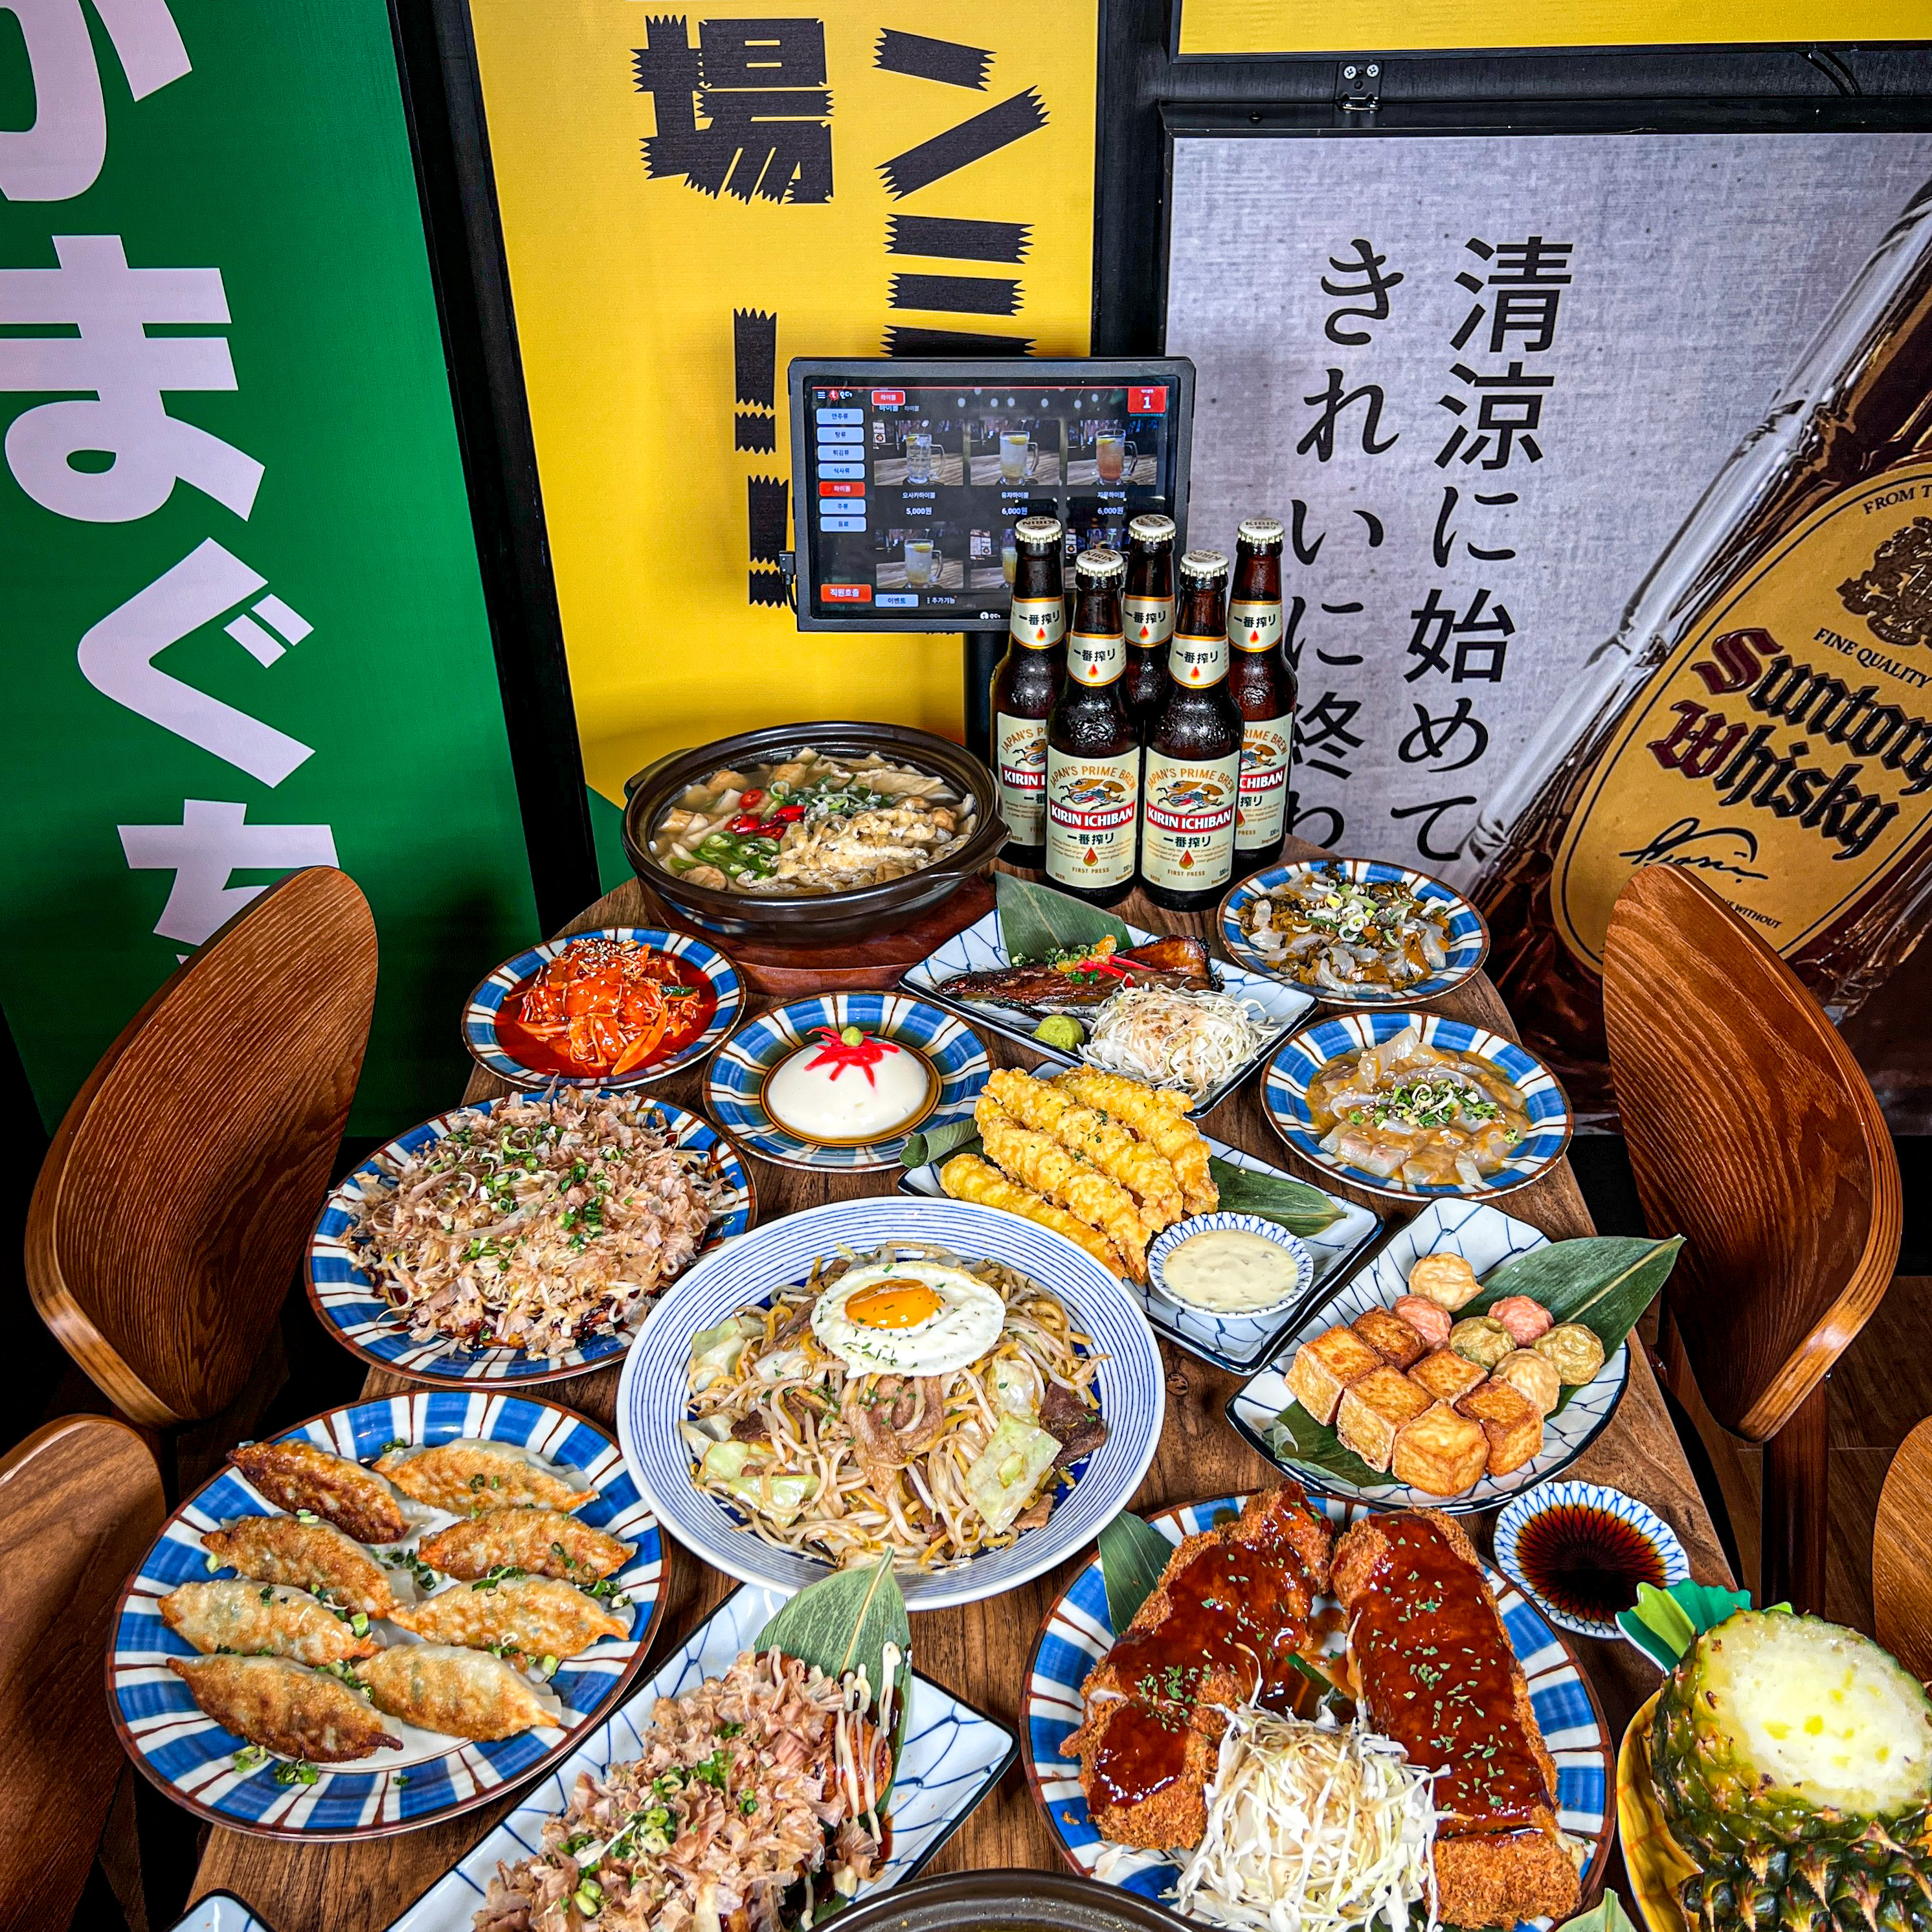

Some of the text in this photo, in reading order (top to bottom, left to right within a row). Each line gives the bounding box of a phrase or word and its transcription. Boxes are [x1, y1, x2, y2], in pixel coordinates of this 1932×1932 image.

[1143, 396, 1151, 409] 1
[1863, 487, 1915, 515] FROM
[1084, 551, 1116, 563] KIRIN
[1389, 236, 1573, 862] 清涼に始めて
[830, 588, 860, 598] 직원호출
[1019, 609, 1060, 625] 一番搾り
[1125, 610, 1167, 625] 一番搾り
[1233, 613, 1276, 629] 一番搾り
[1073, 647, 1116, 662] 一番搾り
[1176, 649, 1219, 665] 一番搾り
[1813, 627, 1932, 688] FINE QUALITY
[1691, 628, 1932, 795] Suntory
[1002, 728, 1033, 754] JAPAN'S
[1270, 733, 1288, 756] BREW
[1004, 769, 1038, 786] KIRIN
[1050, 766, 1079, 788] JAPAN'S
[1082, 766, 1118, 778] PRIME
[1118, 769, 1137, 791] BREW
[1147, 768, 1235, 794] JAPAN'S PRIME BREW
[1239, 770, 1283, 789] CHIBAN
[1646, 699, 1901, 860] Whisky
[1051, 804, 1082, 826] KIRIN
[1084, 806, 1134, 827] ICHIBAN
[1148, 807, 1179, 829] KIRIN
[1181, 809, 1231, 830] ICHIBAN
[1067, 832, 1114, 846] 一番搾り
[1163, 835, 1211, 848] 一番搾り
[1735, 904, 1782, 929] WITHOUT
